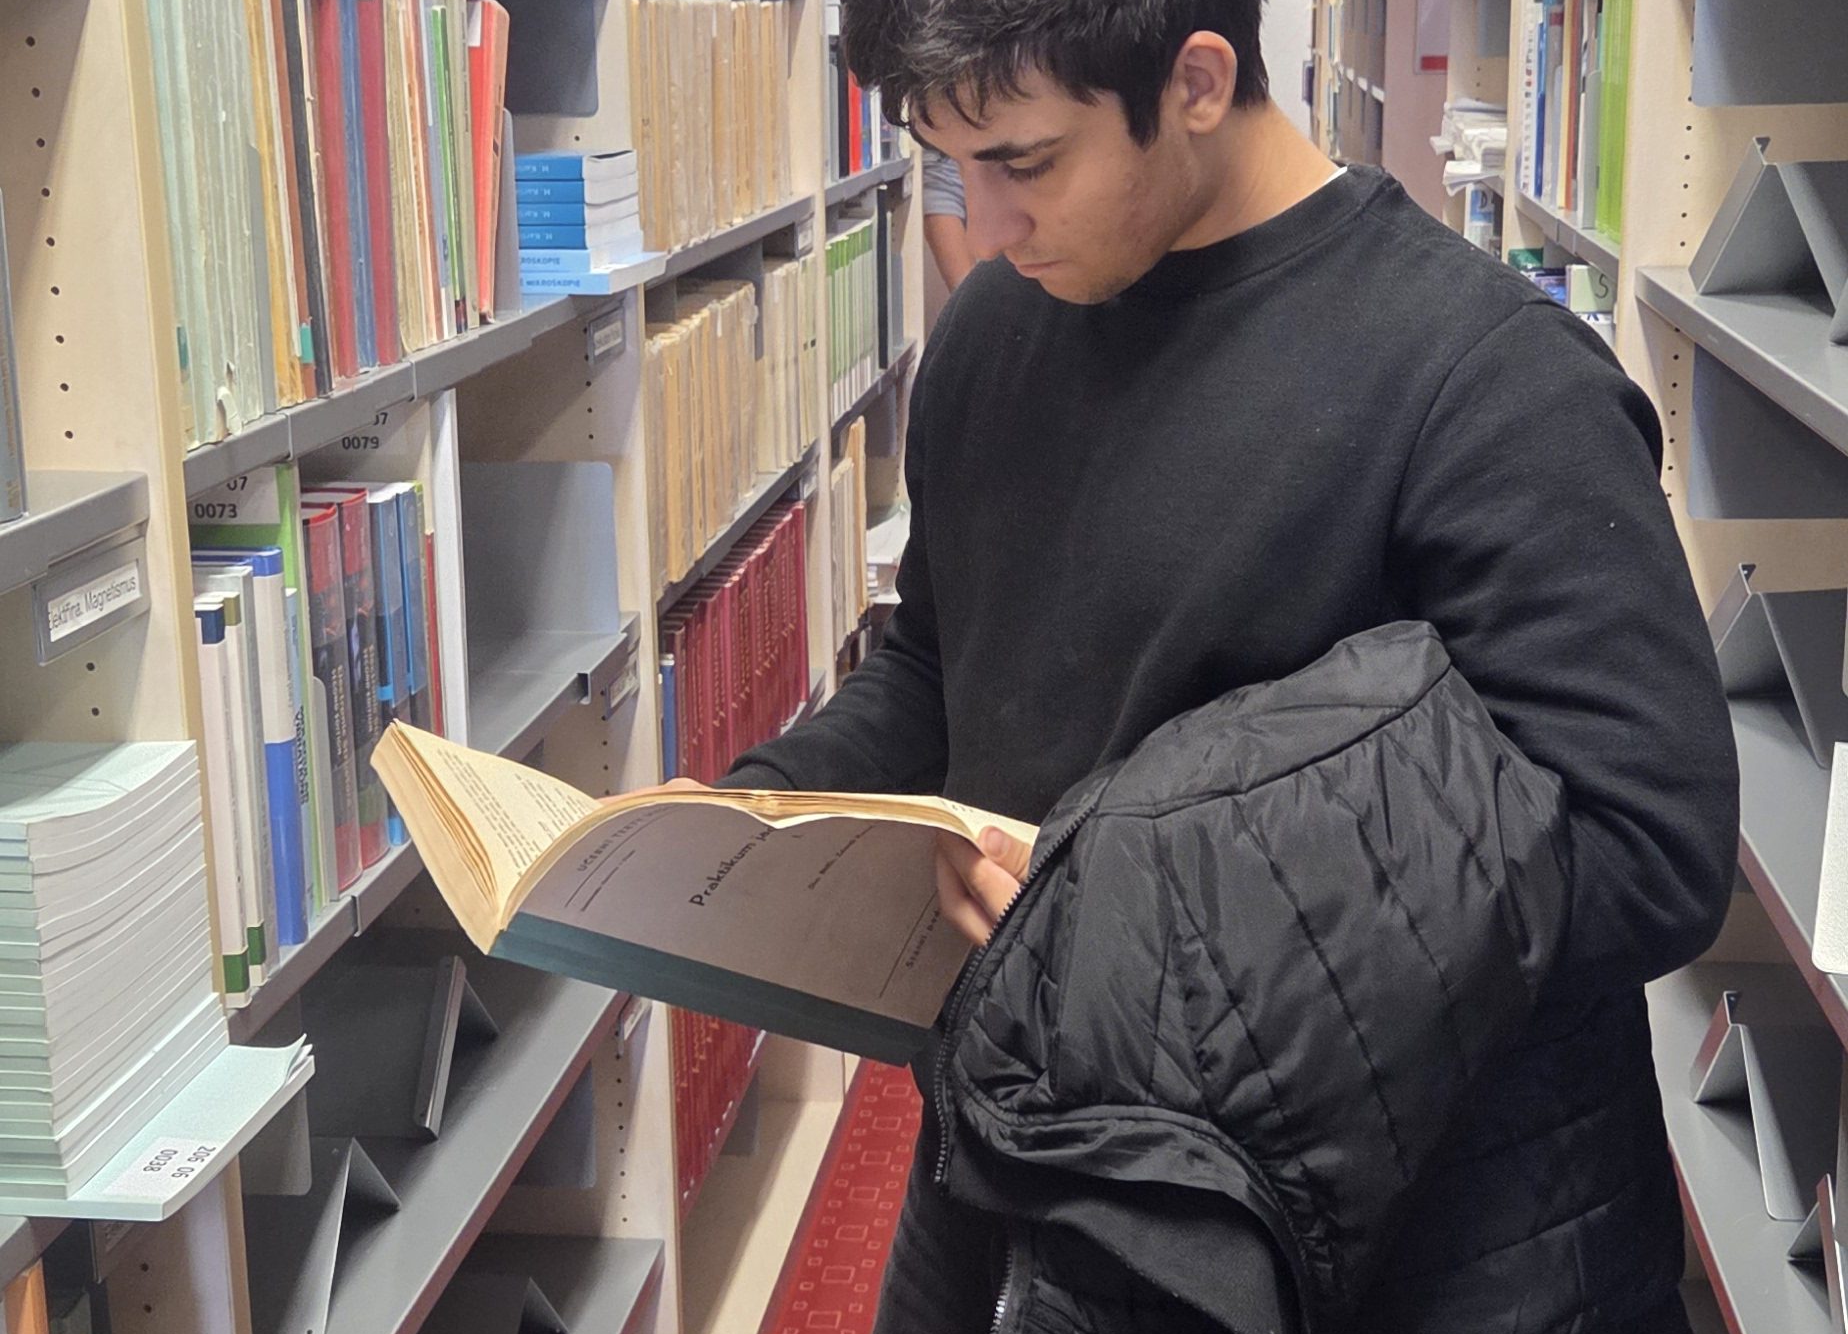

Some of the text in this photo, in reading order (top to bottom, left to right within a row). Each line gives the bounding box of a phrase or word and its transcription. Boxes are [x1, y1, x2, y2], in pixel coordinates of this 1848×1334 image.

[341, 436, 380, 450] 0079
[194, 503, 238, 519] 0073
[688, 840, 757, 907] Praktikum
[143, 1149, 178, 1172] 0038
[171, 1145, 217, 1178] 206 06
